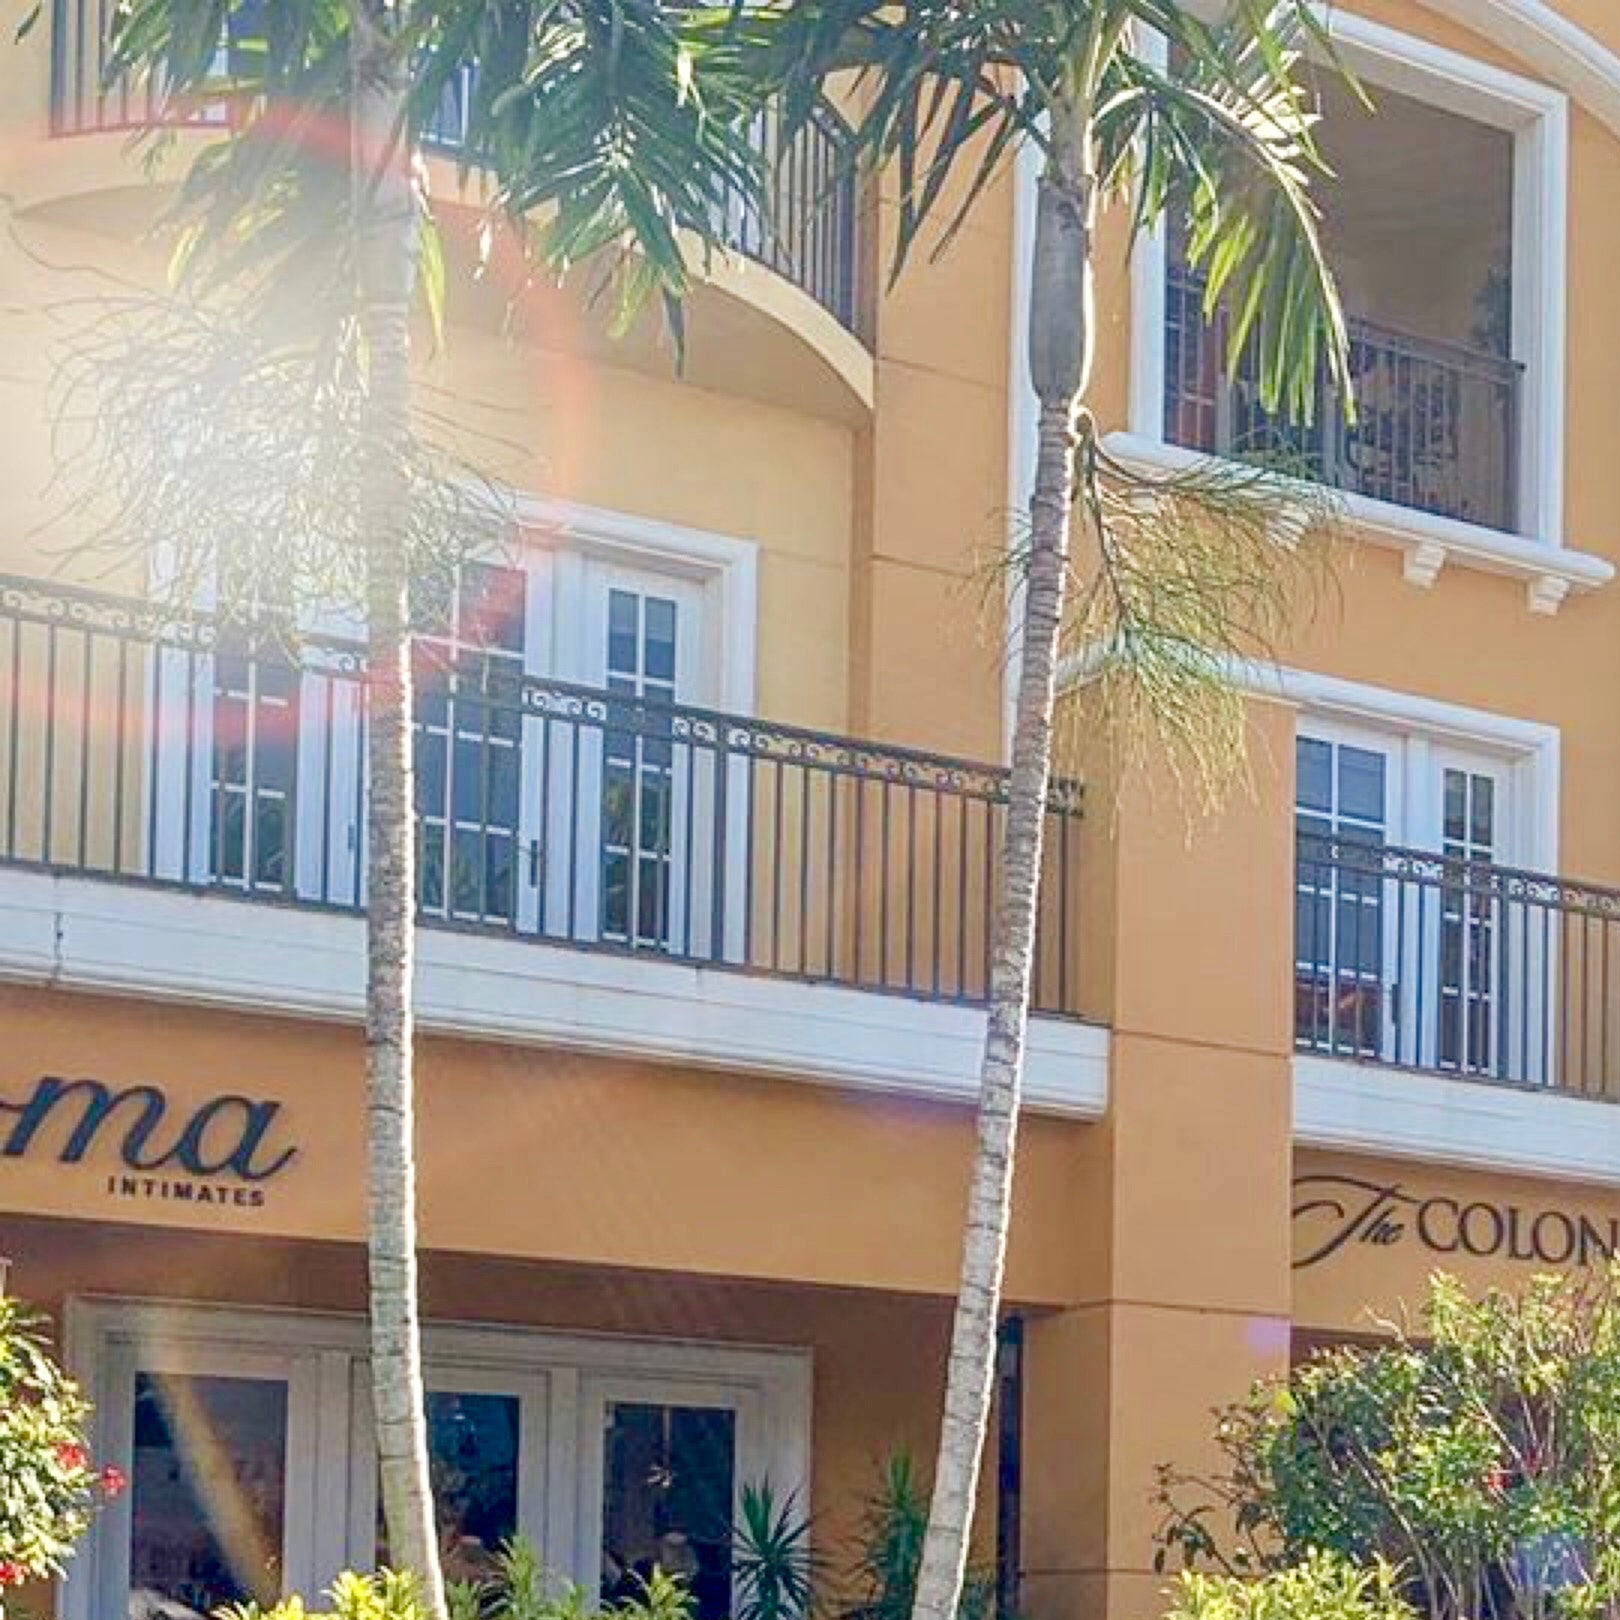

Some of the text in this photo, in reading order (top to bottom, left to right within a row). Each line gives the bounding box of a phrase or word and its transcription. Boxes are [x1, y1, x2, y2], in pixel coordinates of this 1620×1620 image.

[0, 1076, 298, 1181] ma
[107, 1174, 266, 1208] INTIMATES
[1291, 1175, 1422, 1270] The
